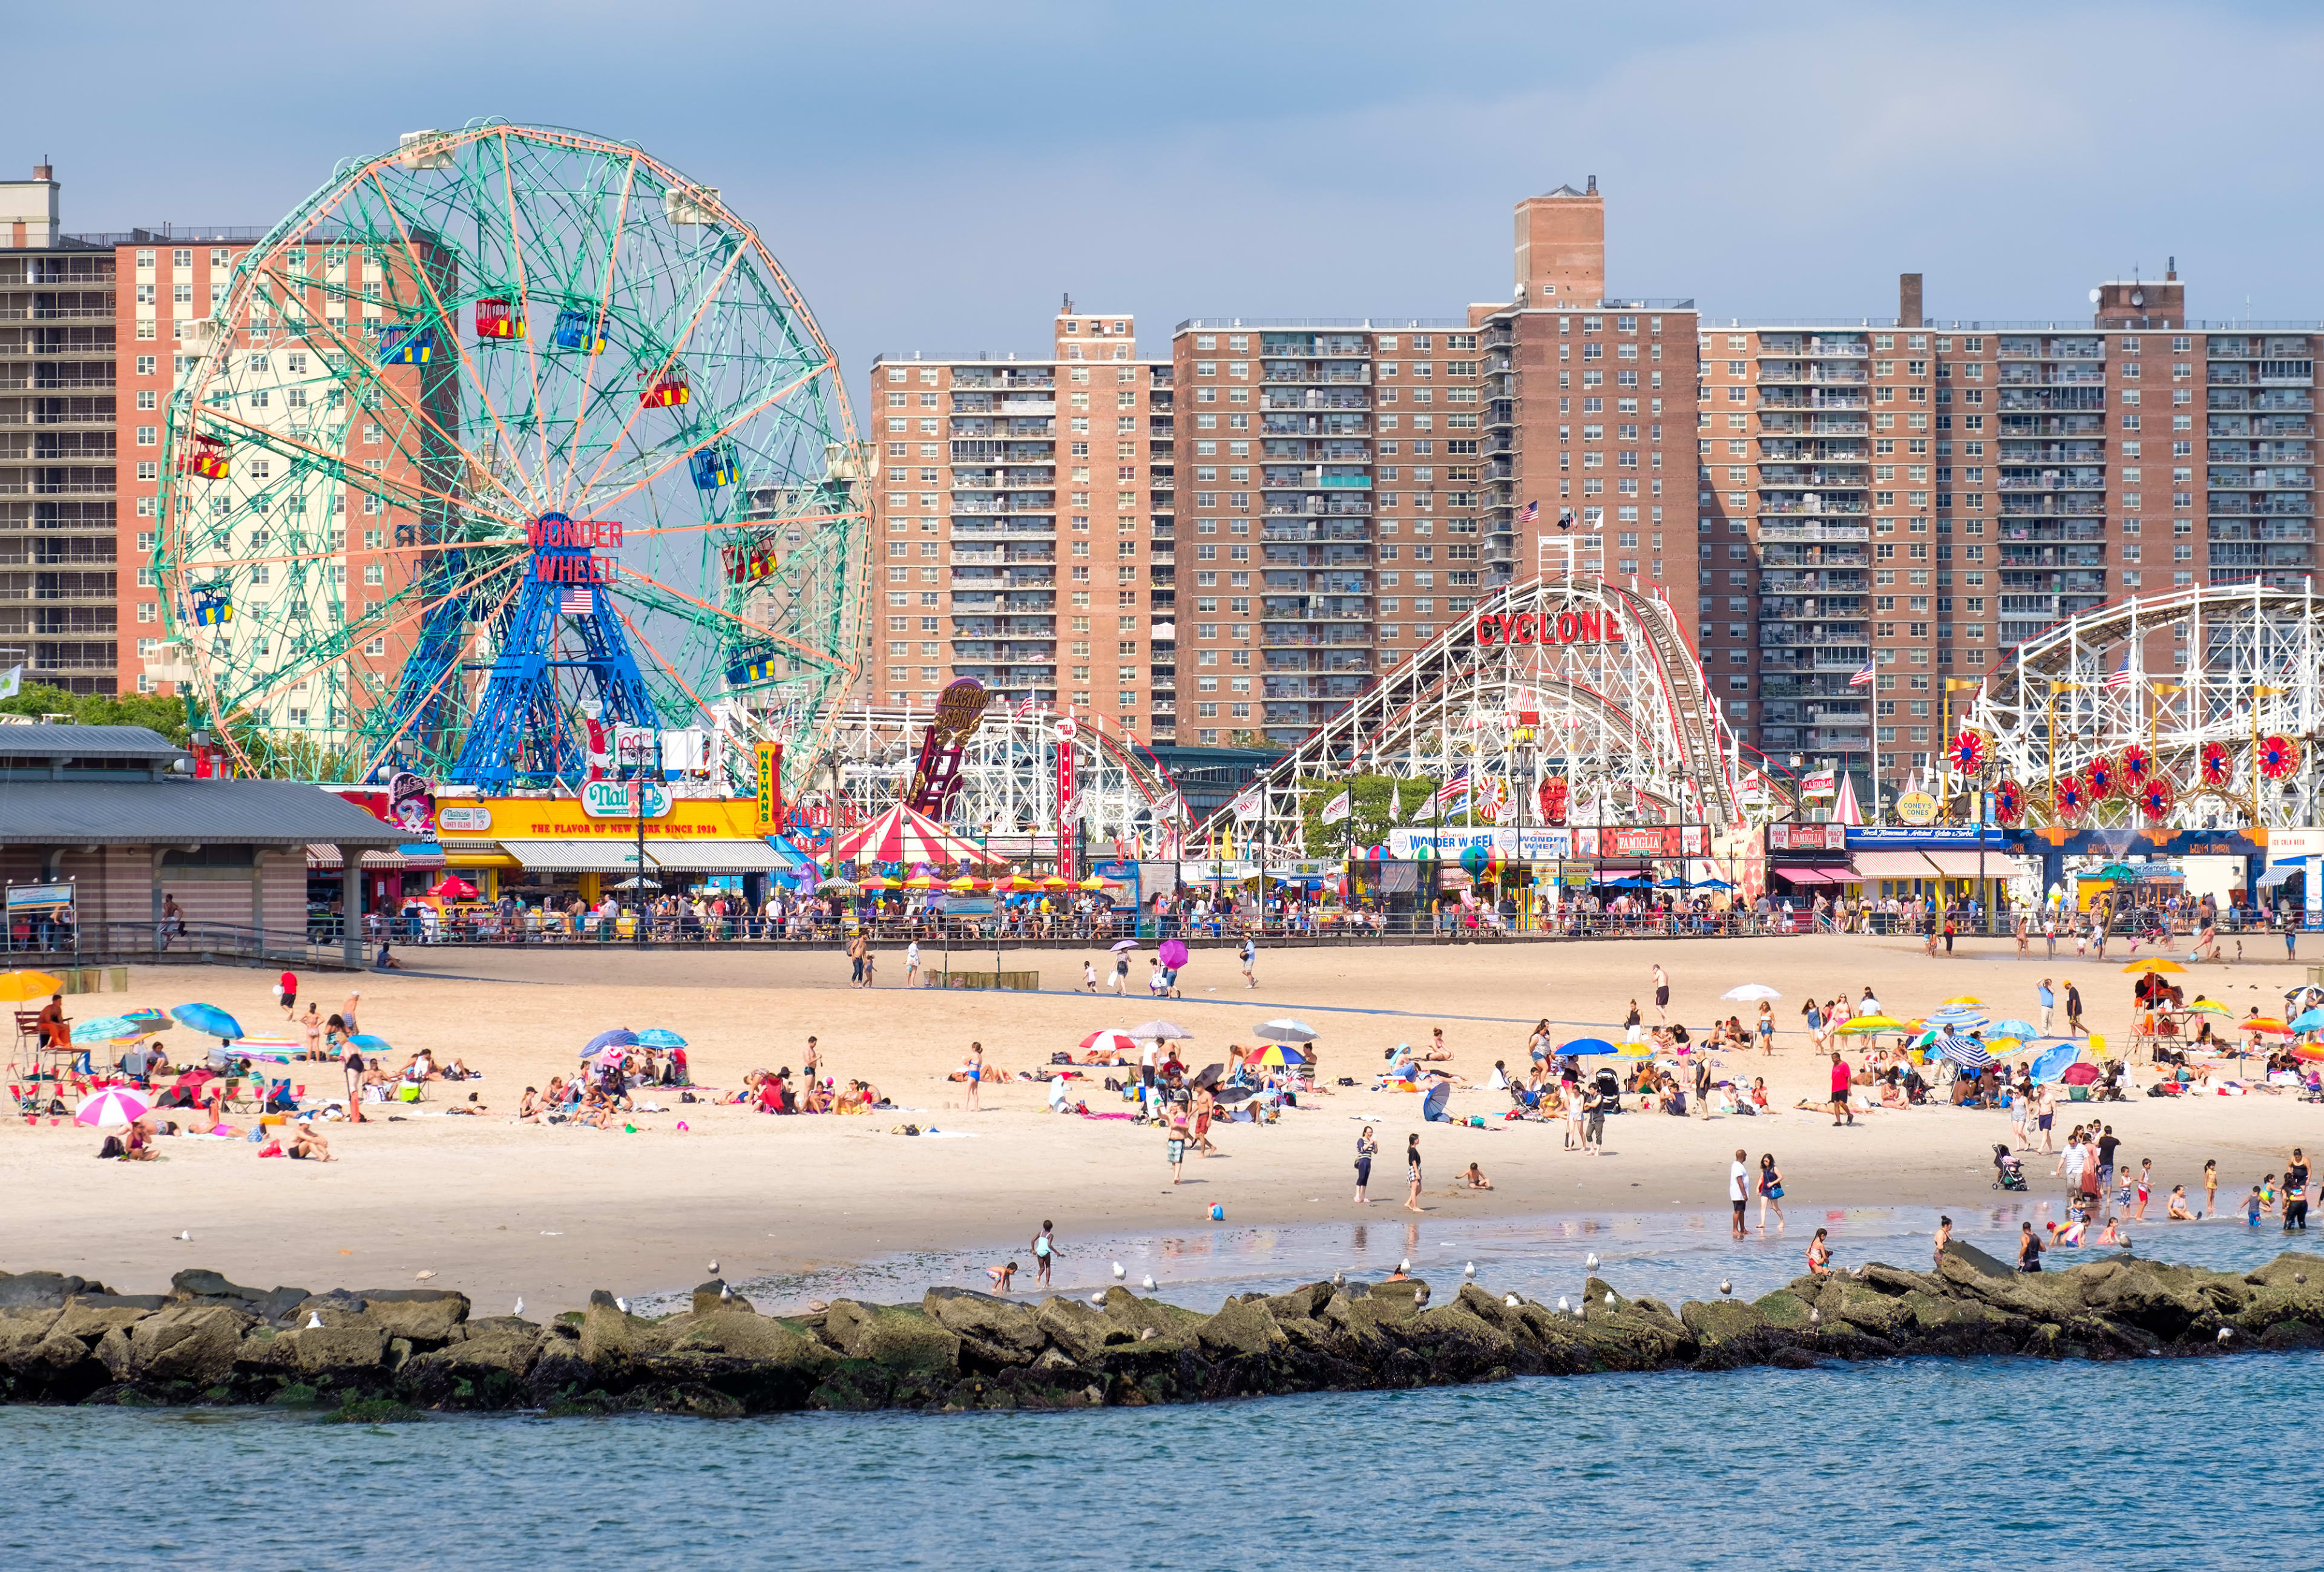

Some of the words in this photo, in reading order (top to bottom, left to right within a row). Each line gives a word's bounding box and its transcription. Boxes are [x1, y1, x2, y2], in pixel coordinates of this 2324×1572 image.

[525, 519, 623, 547] WONDER
[535, 555, 619, 583] WHEEL
[1477, 608, 1623, 645] CYCLONE
[939, 687, 990, 709] ELECTRO
[943, 708, 972, 728] SPIN
[760, 750, 769, 822] NATHANS
[422, 833, 436, 841] HOP
[531, 824, 550, 833] THE
[554, 824, 591, 833] FLAVOR
[594, 824, 606, 833] OF
[611, 824, 631, 834] NEW
[665, 824, 692, 834] SINCE
[697, 824, 717, 834] 1916
[1792, 833, 1822, 843] FAMIGLIA
[1409, 834, 1455, 850] WONDER
[1618, 837, 1659, 849] FAMIGLIA
[2190, 844, 2209, 853] LUNA
[2211, 844, 2230, 853] PARK
